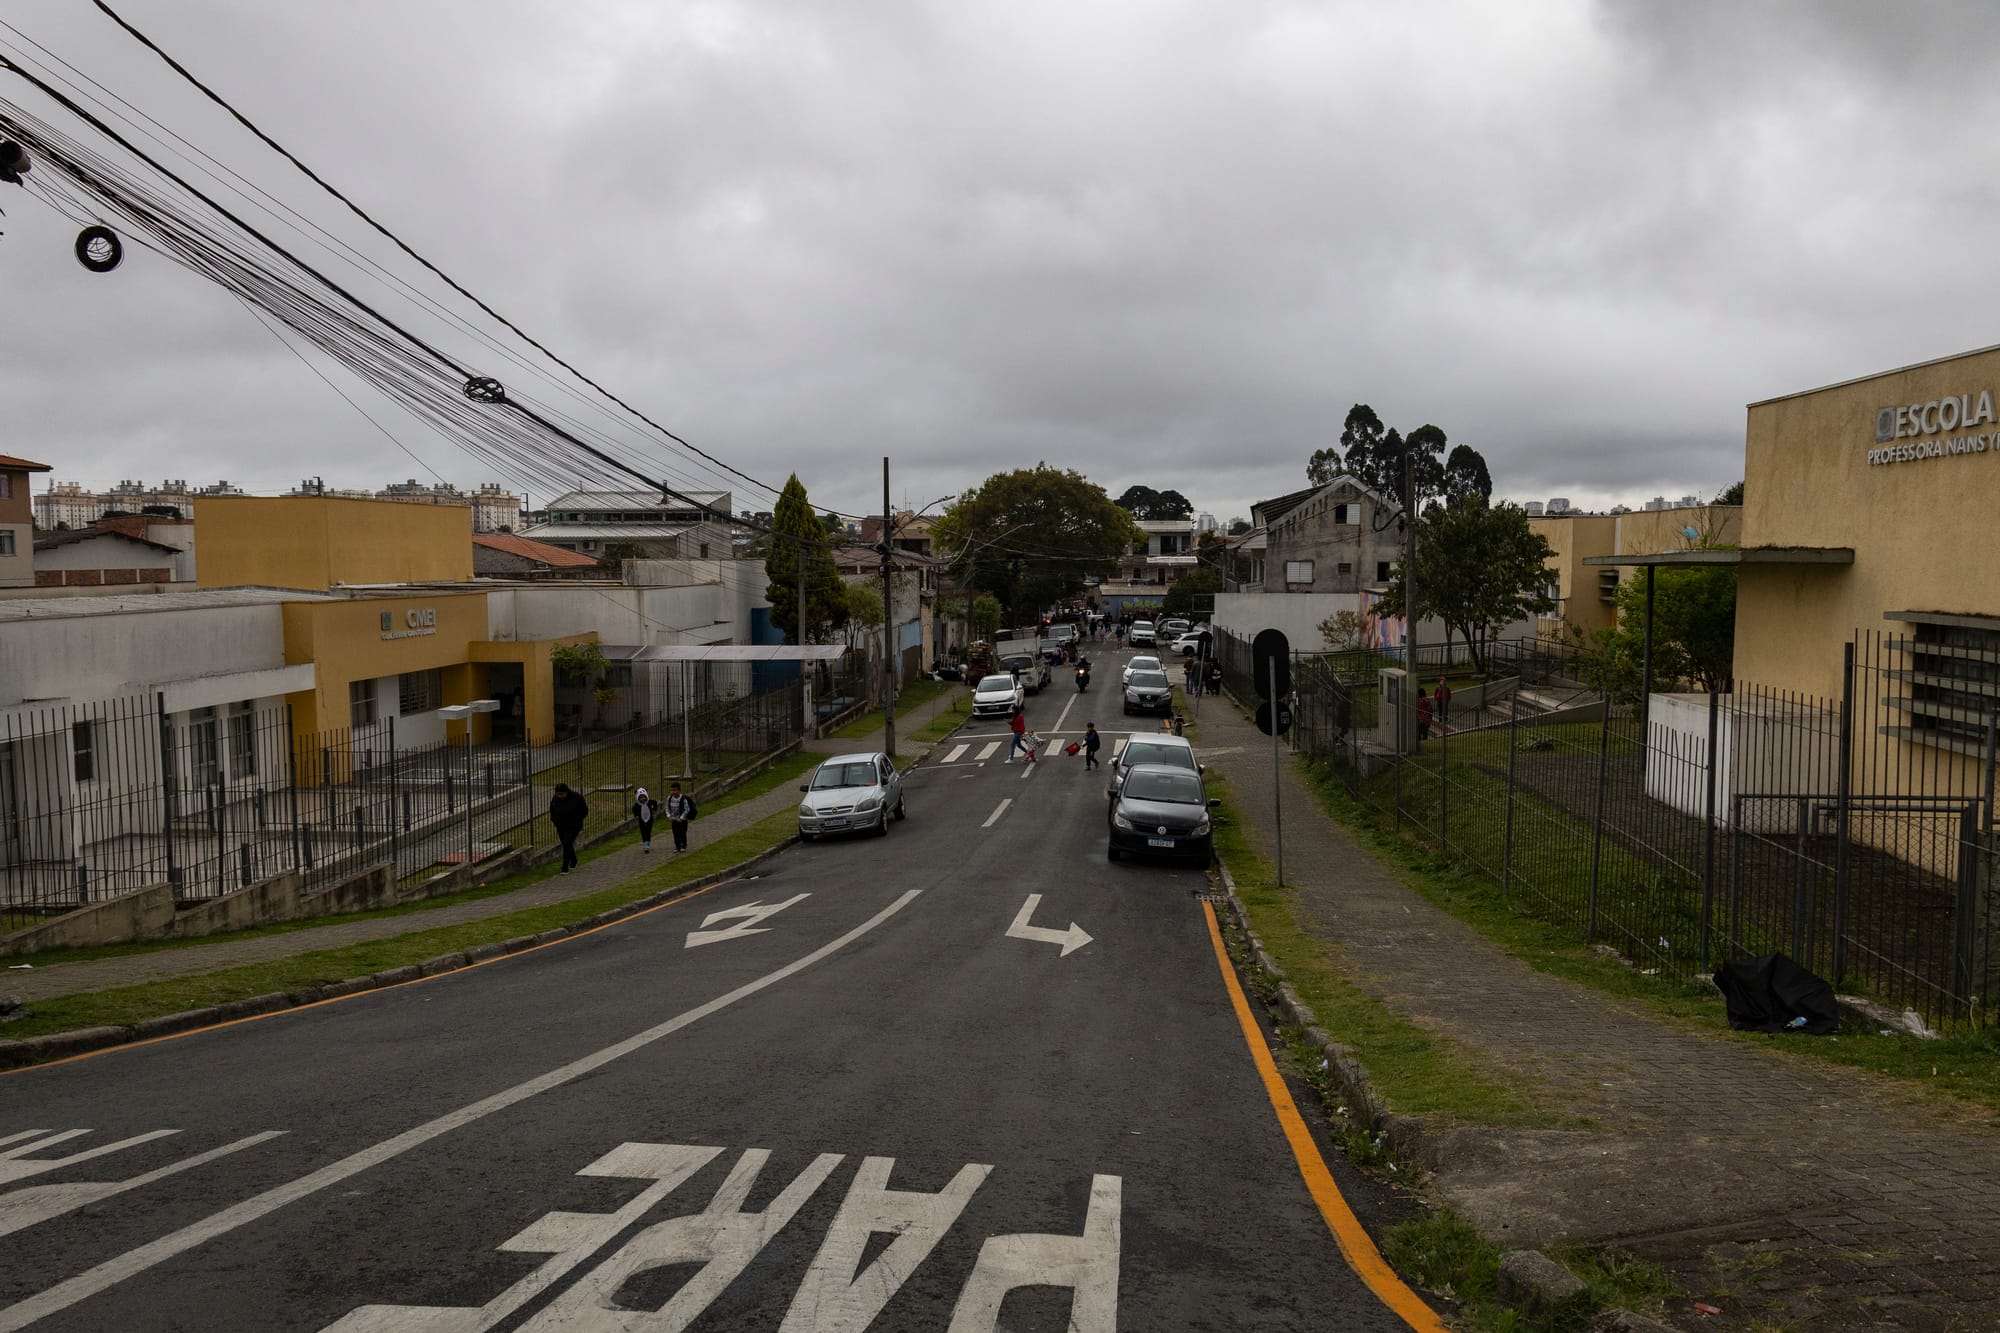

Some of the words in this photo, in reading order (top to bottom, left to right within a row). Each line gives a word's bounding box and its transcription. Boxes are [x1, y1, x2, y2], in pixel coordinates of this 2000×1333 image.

[1895, 390, 1997, 438] ESCOLA
[1867, 440, 1943, 465] PROFESSORA
[407, 608, 436, 628] CMEI
[315, 1142, 1122, 1333] PARE
